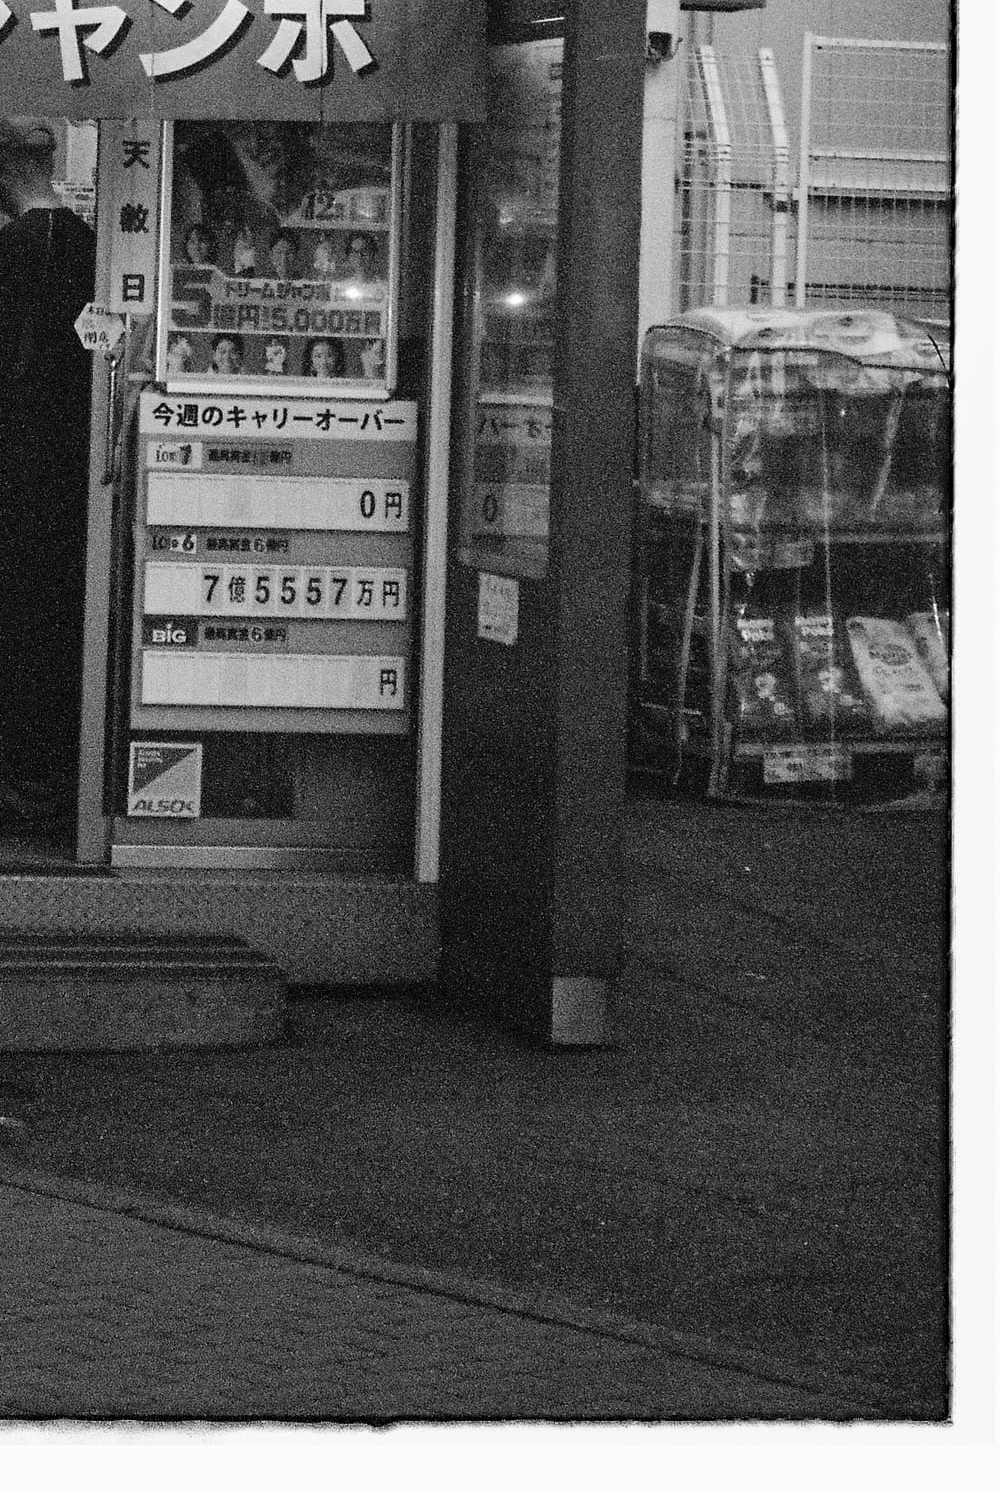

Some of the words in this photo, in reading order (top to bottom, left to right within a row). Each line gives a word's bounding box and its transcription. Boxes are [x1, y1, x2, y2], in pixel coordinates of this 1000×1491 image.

[152, 401, 406, 431] 今週のキャリーオーバー
[359, 490, 402, 520] 0円
[203, 574, 400, 607] 7億5557万円
[151, 625, 187, 643] BIG
[379, 668, 398, 696] 円
